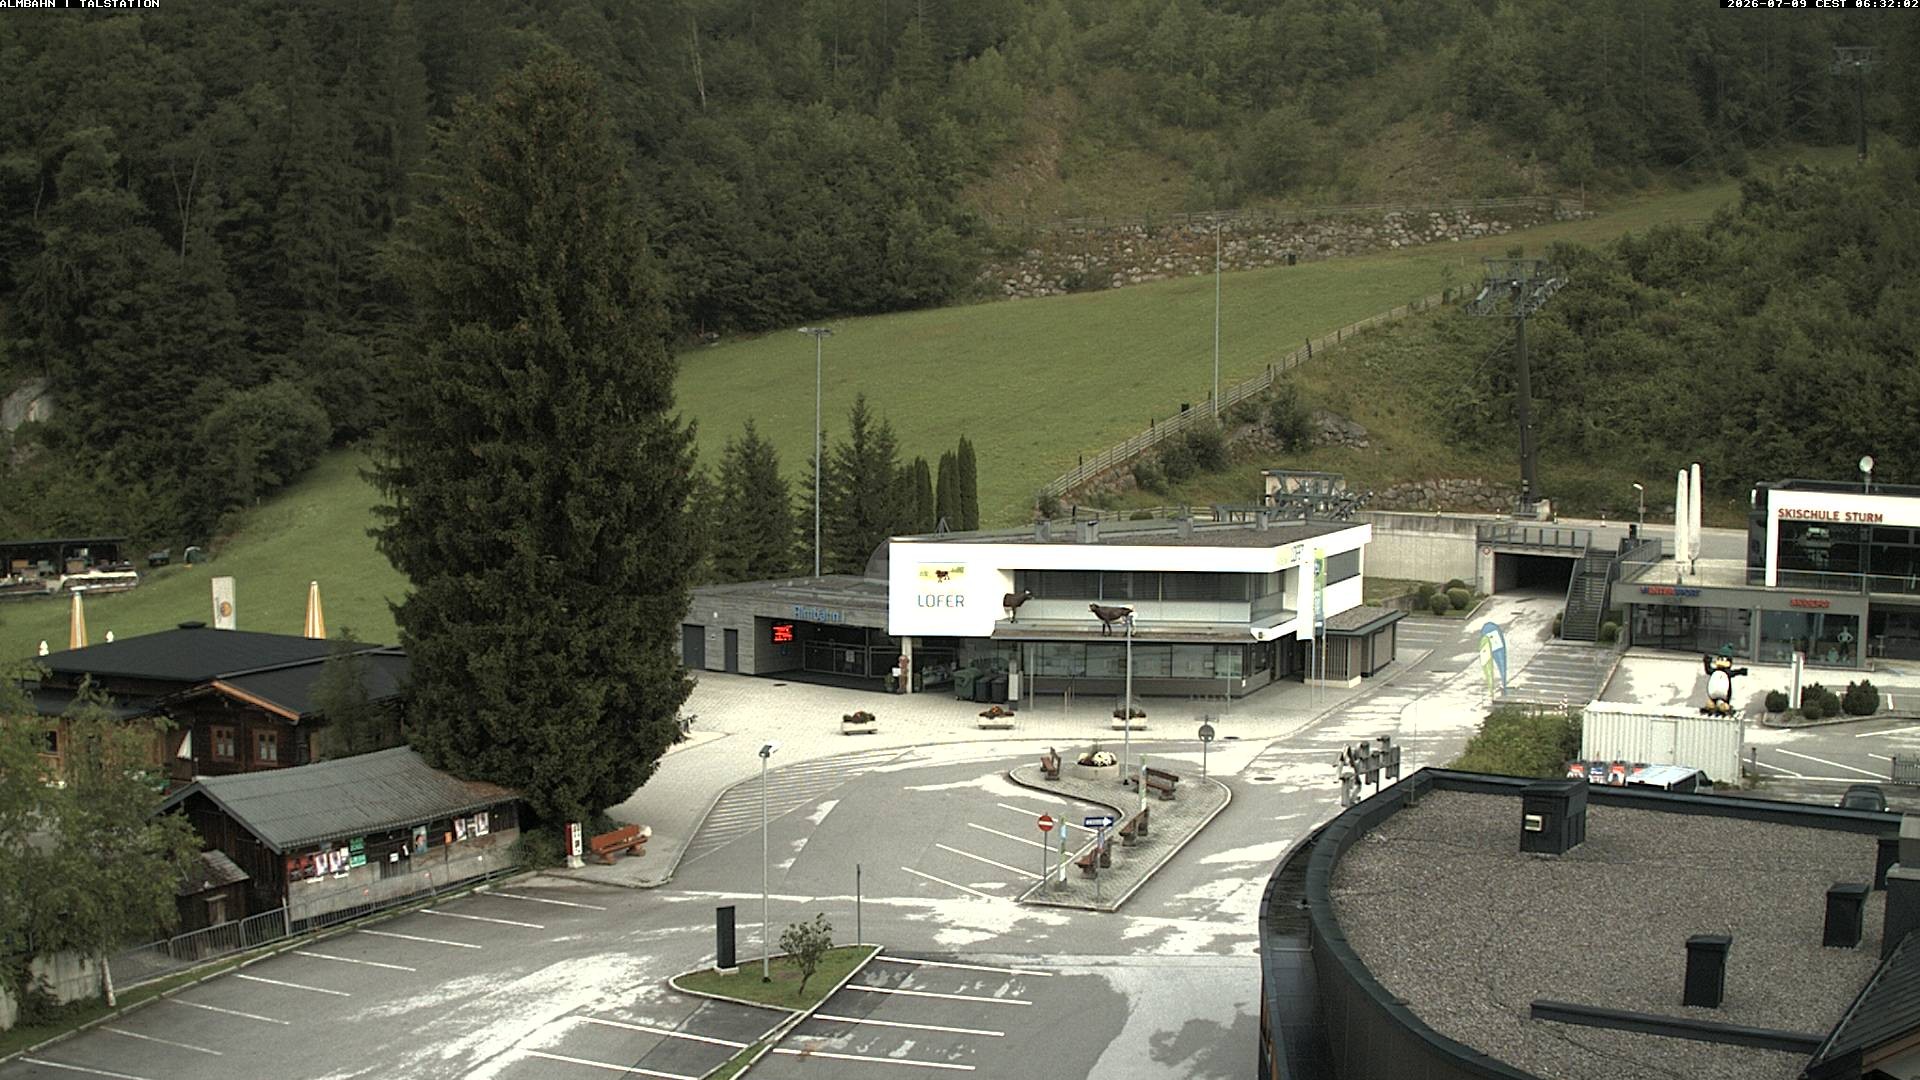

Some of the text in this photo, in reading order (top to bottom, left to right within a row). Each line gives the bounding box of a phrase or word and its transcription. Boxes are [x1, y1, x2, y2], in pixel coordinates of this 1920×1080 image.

[1778, 508, 1884, 523] SKISCHULE STURM
[917, 594, 965, 608] LOFER
